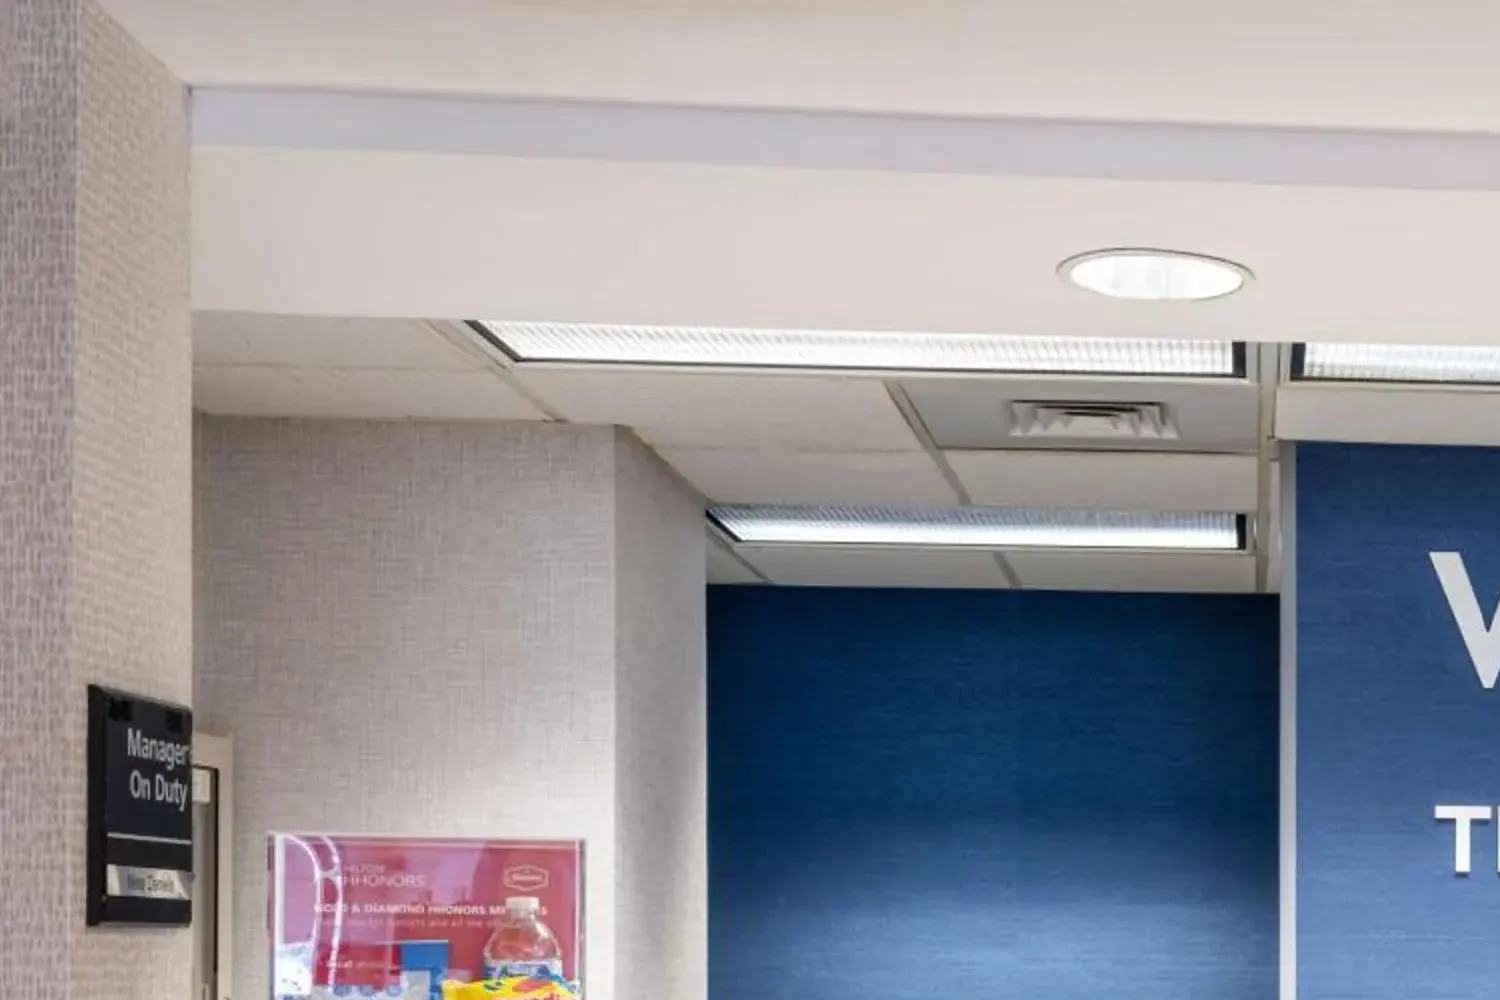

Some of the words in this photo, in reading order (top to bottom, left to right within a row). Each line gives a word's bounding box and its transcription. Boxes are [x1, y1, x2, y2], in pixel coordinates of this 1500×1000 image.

[127, 727, 190, 770] Manager
[130, 769, 151, 799] On
[155, 773, 188, 812] Duty
